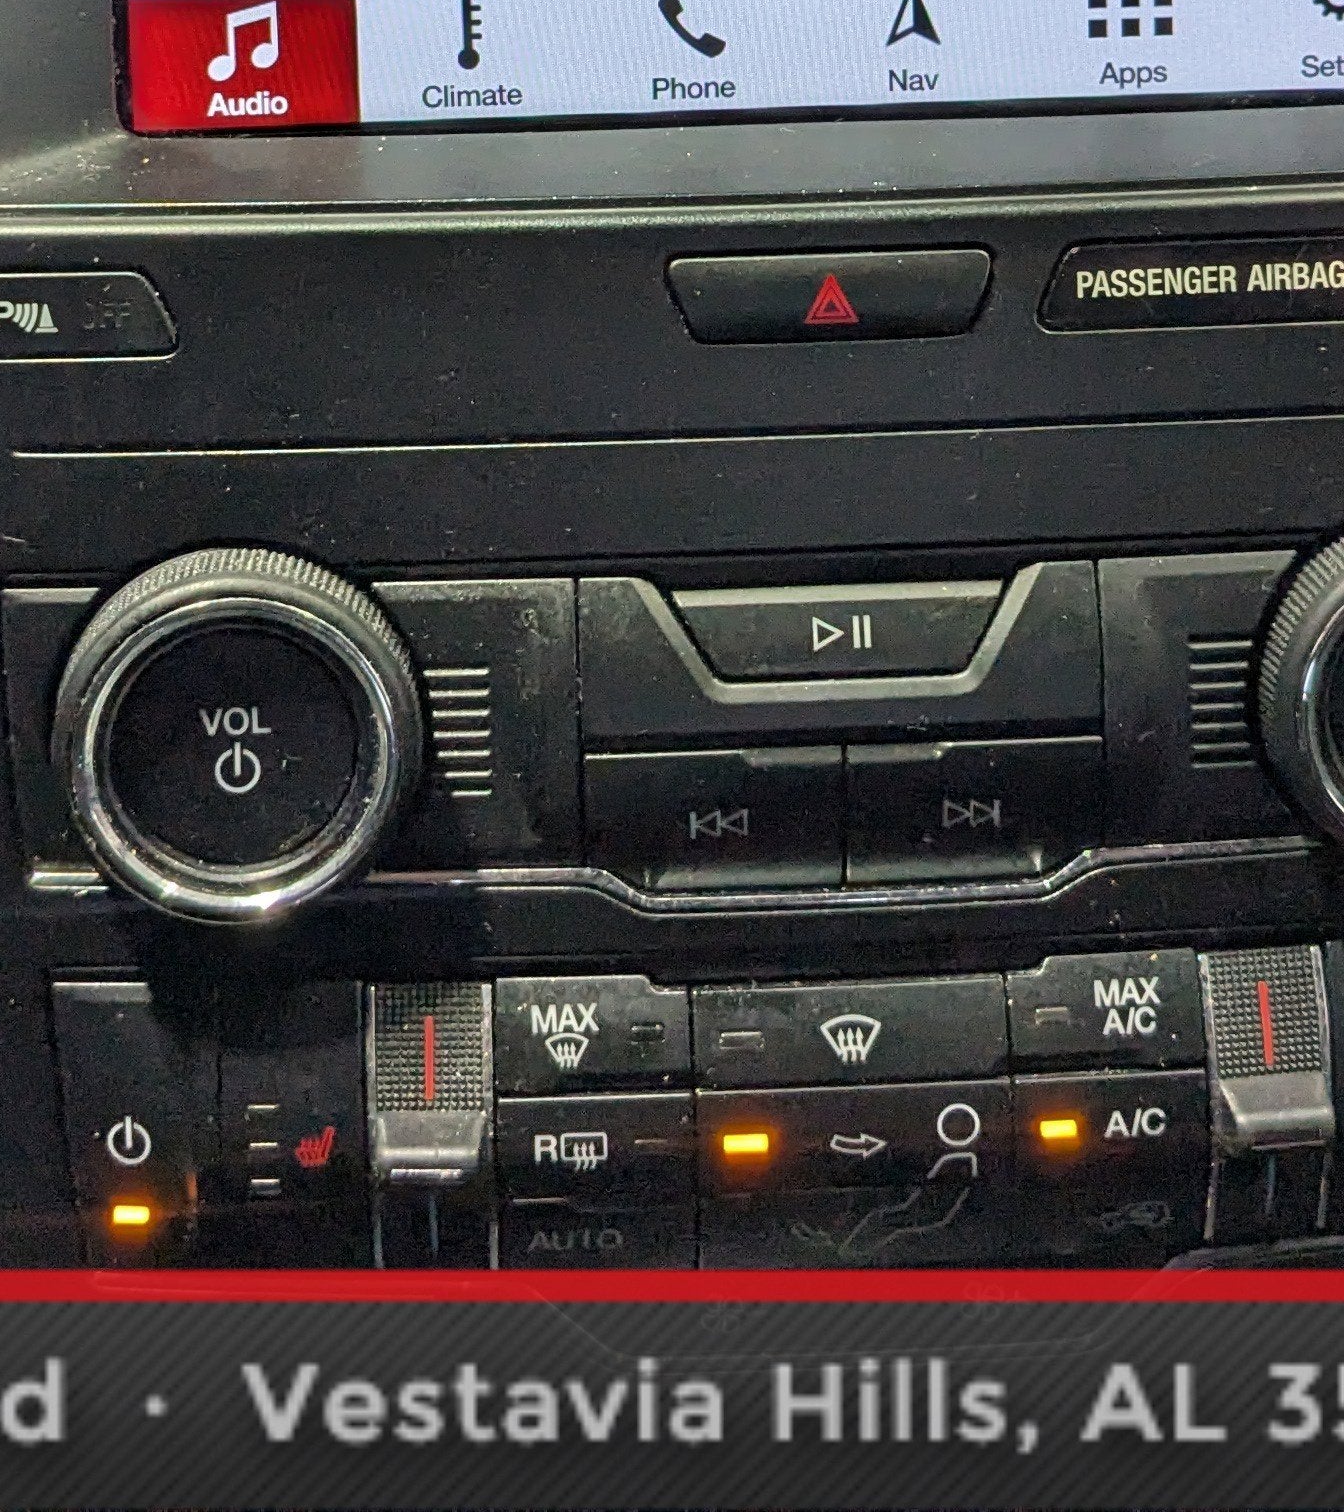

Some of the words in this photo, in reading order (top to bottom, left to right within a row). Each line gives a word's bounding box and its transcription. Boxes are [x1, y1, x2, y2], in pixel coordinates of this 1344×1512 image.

[888, 68, 939, 92] Nav
[1099, 60, 1168, 87] Apps
[422, 83, 523, 109] Climate
[651, 76, 736, 101] Phone
[207, 91, 289, 118] Audio
[1076, 268, 1237, 299] PASSENGER
[199, 707, 272, 737] VOL
[1093, 976, 1160, 1008] MAX
[530, 1003, 599, 1034] MAX
[1103, 1007, 1157, 1036] A/C
[1104, 1107, 1167, 1139] A/C
[534, 1134, 556, 1161] R
[527, 1226, 624, 1252] AUTO
